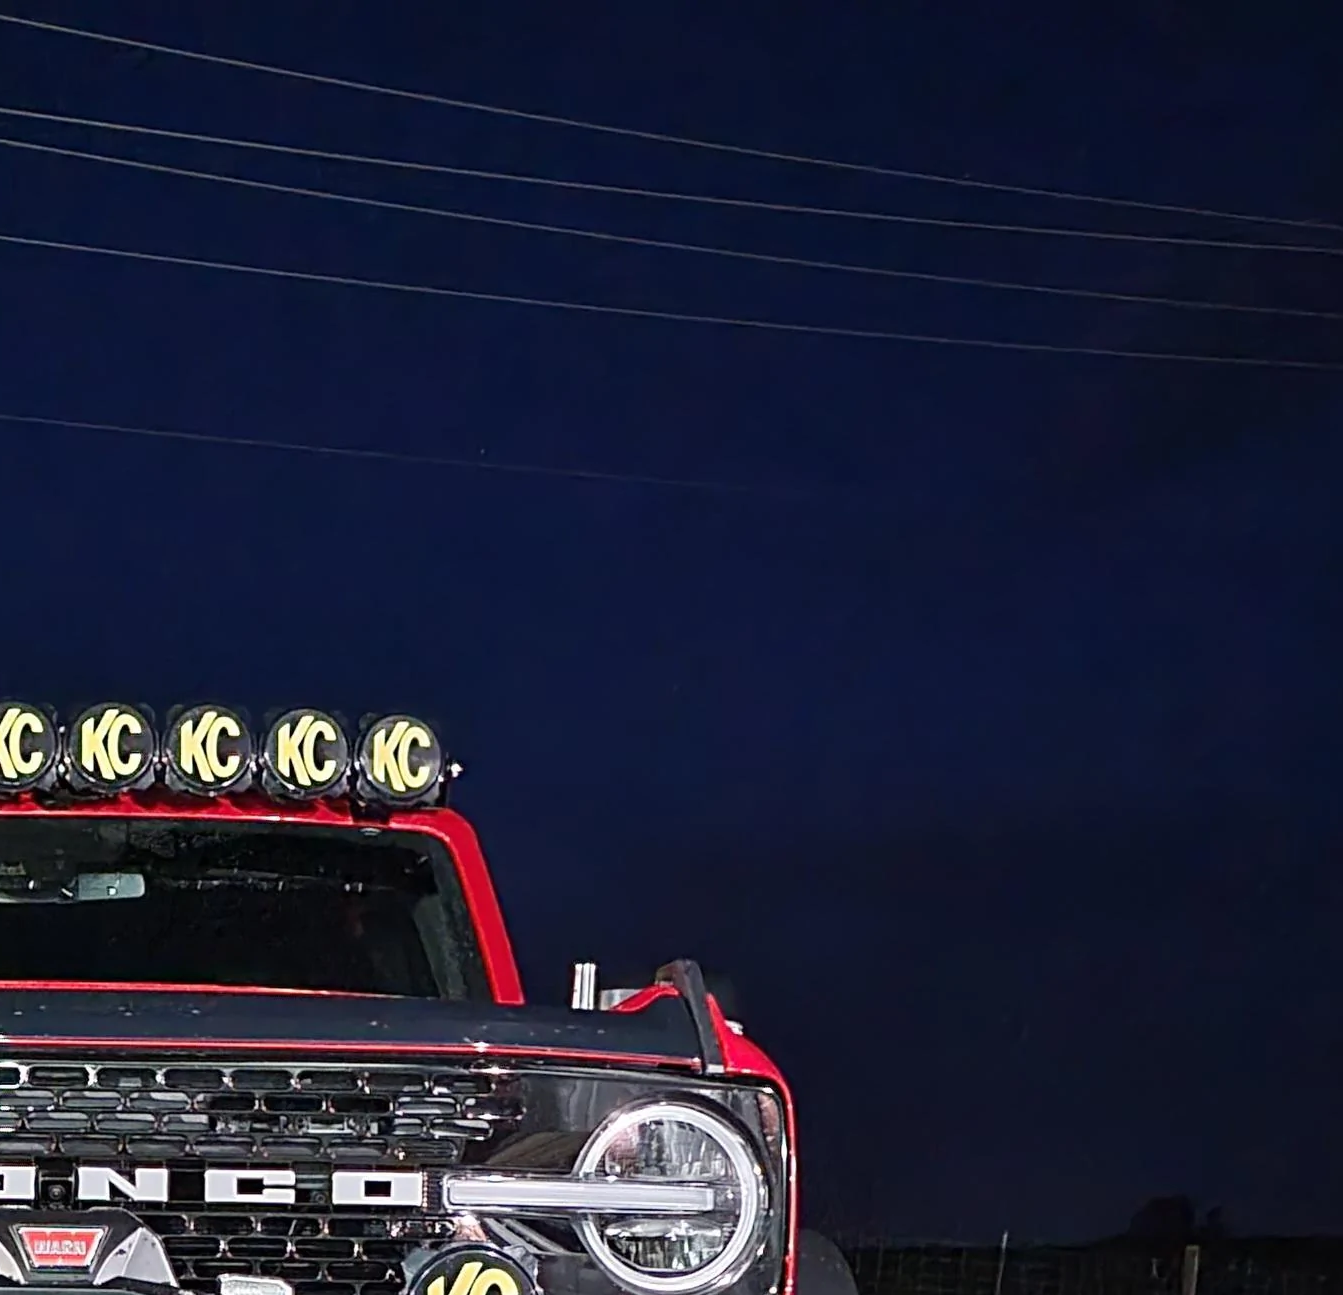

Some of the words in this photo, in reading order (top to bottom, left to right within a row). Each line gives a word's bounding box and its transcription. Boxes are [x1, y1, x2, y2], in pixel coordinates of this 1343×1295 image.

[82, 709, 142, 780] KC
[180, 711, 240, 782] KC
[278, 715, 336, 786] KC
[373, 721, 431, 792] KC
[34, 1239, 87, 1256] WARN
